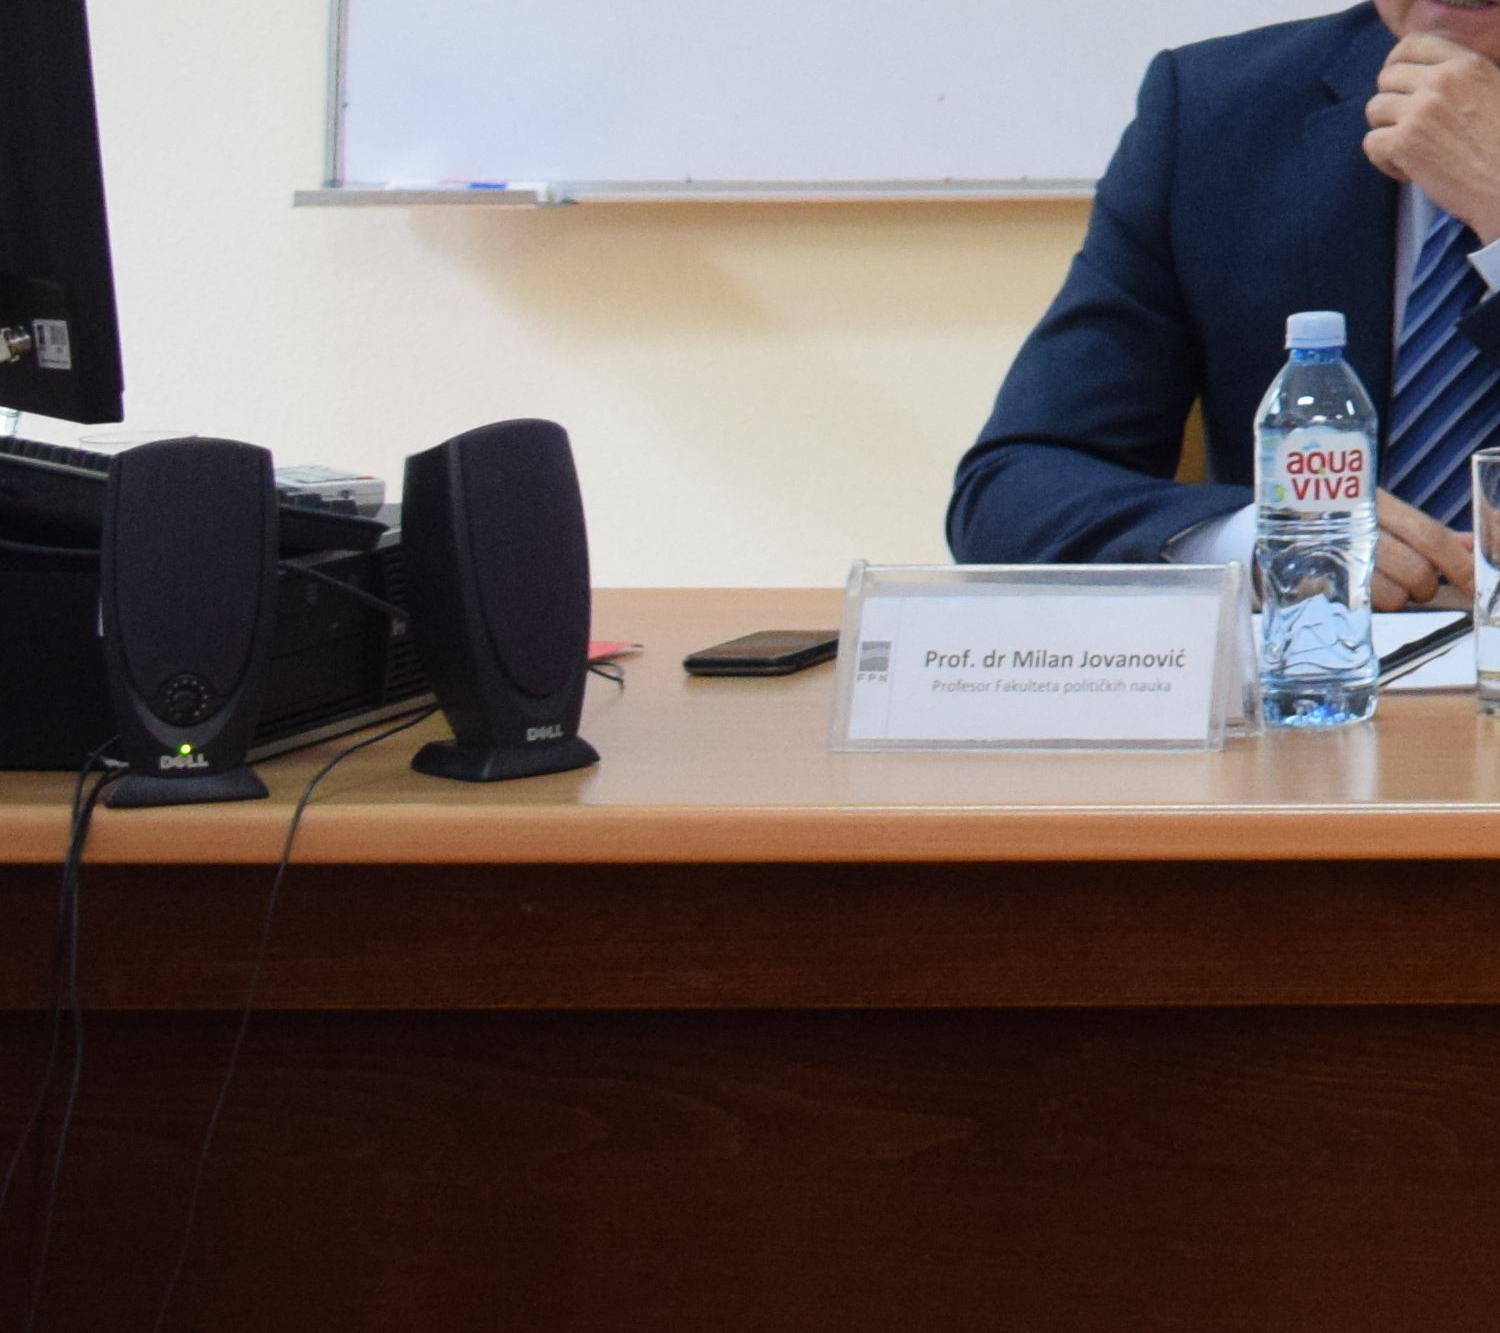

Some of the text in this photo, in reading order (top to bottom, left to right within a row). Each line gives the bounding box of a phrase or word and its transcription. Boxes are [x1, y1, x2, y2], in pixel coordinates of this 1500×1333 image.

[1286, 449, 1363, 475] aqua
[1291, 476, 1360, 501] viva
[924, 648, 1186, 668] Prof. dr Milan Jovanović
[932, 678, 1172, 695] Profesor Fakulteta političkih nauka
